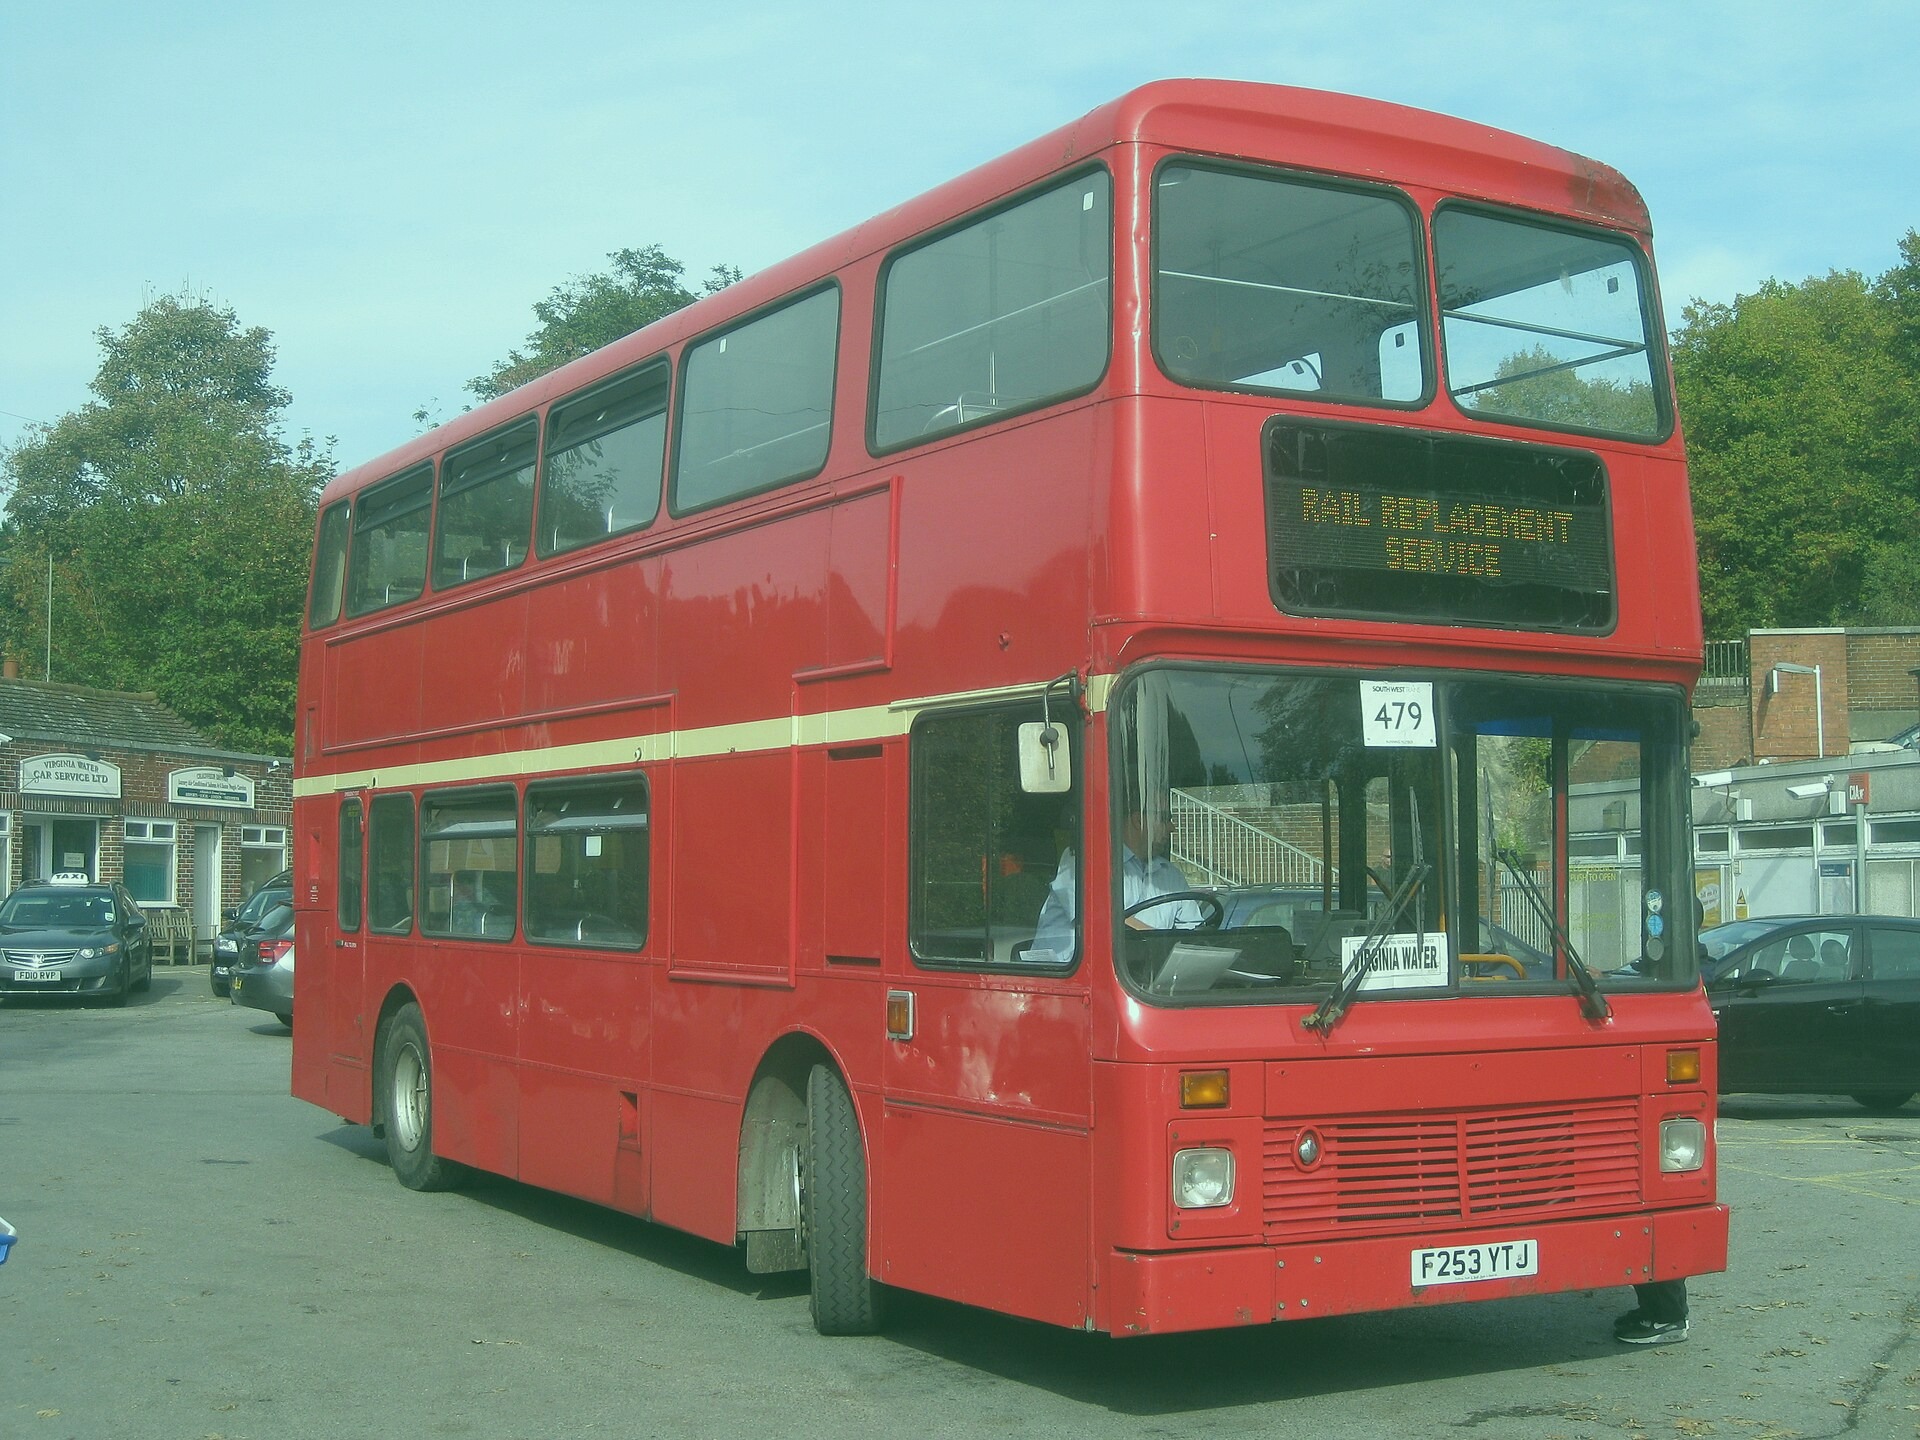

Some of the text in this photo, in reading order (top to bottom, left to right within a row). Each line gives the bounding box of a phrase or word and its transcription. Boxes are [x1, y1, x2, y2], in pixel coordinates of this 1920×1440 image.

[1302, 488, 1573, 543] RAIL REPLACEMENT
[1386, 536, 1501, 577] SERVICE
[1374, 701, 1422, 730] 479
[33, 770, 108, 783] CAR SERVICE LTD
[44, 760, 99, 773] VIRGINIA WATER
[20, 971, 56, 980] FD10 RVP
[1422, 1243, 1528, 1279] F253 YTJ
